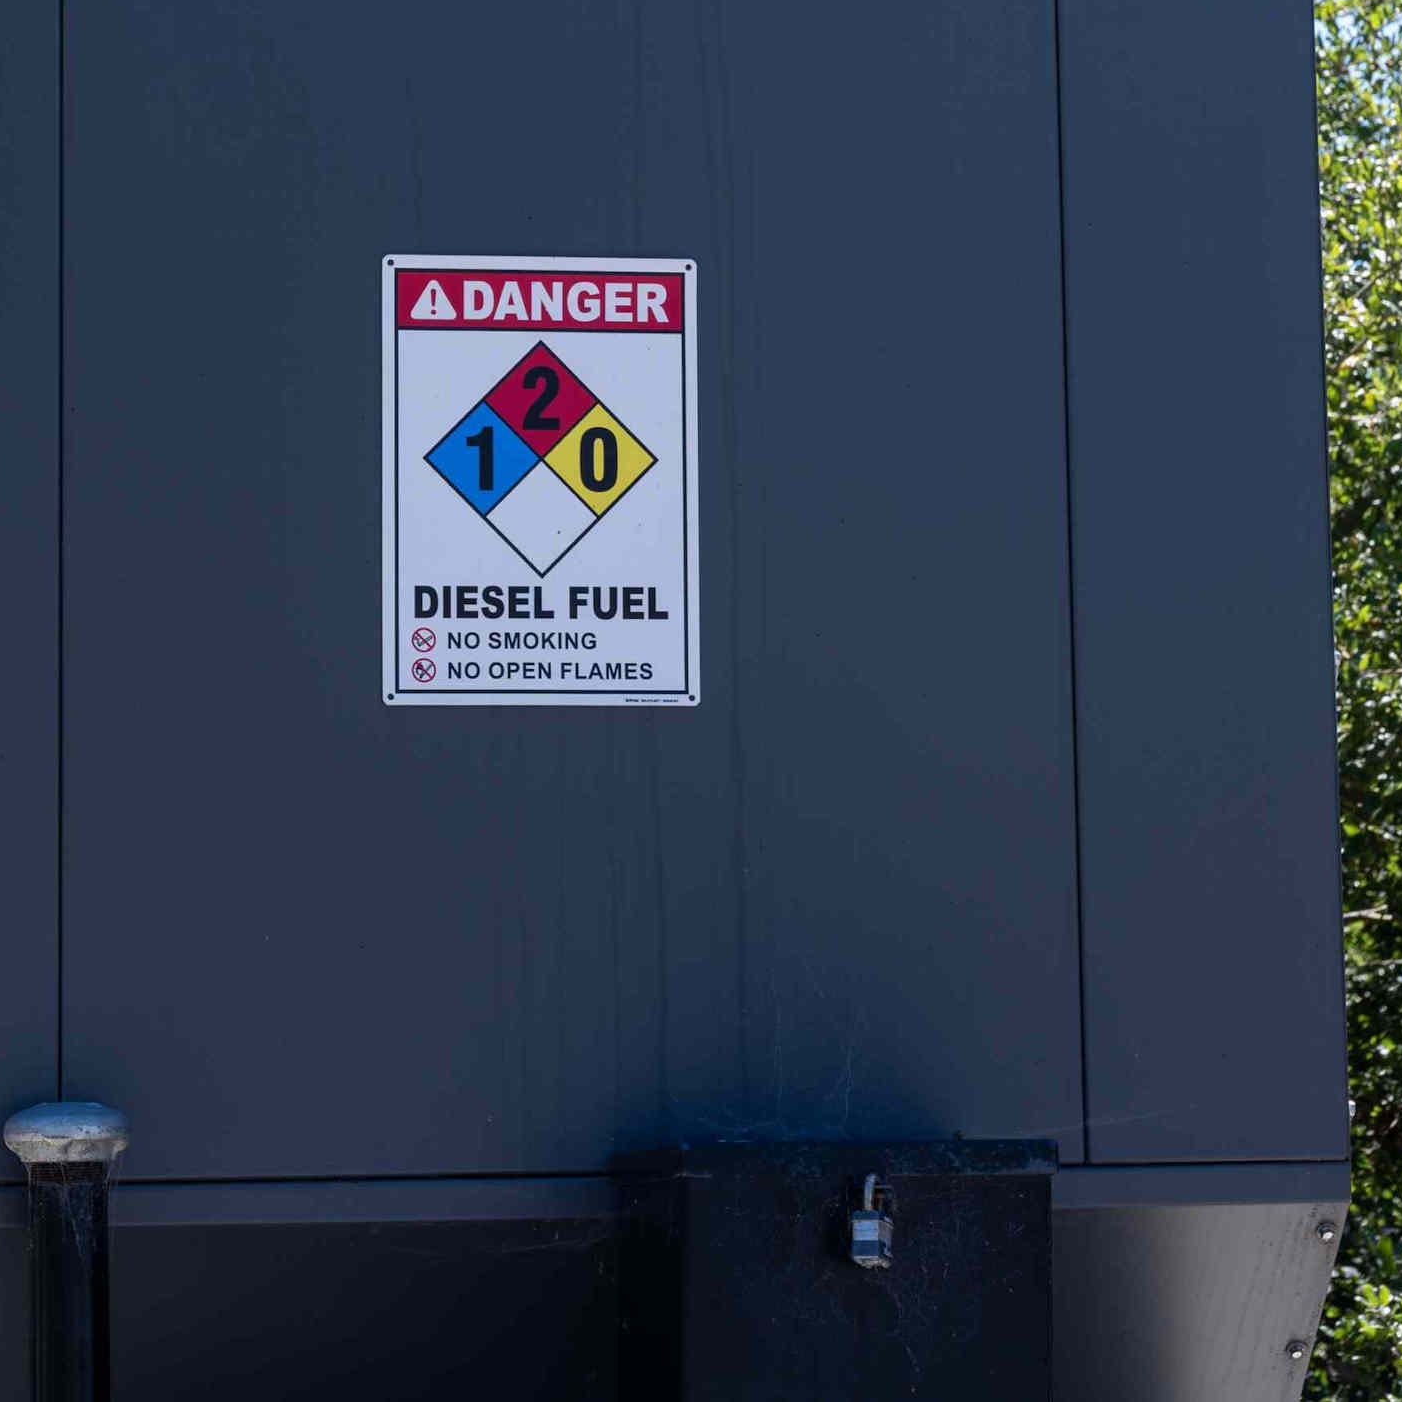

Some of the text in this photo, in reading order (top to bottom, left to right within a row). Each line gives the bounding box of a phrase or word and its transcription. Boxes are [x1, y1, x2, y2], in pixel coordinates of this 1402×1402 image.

[463, 280, 670, 322] DANGER
[522, 366, 560, 430] 2
[466, 426, 494, 491] 1
[579, 427, 618, 492] 0
[414, 585, 669, 620] DIESEL FUEL
[447, 633, 597, 651] NO SMOKING
[447, 663, 654, 681] NO OPEN FLAMES
